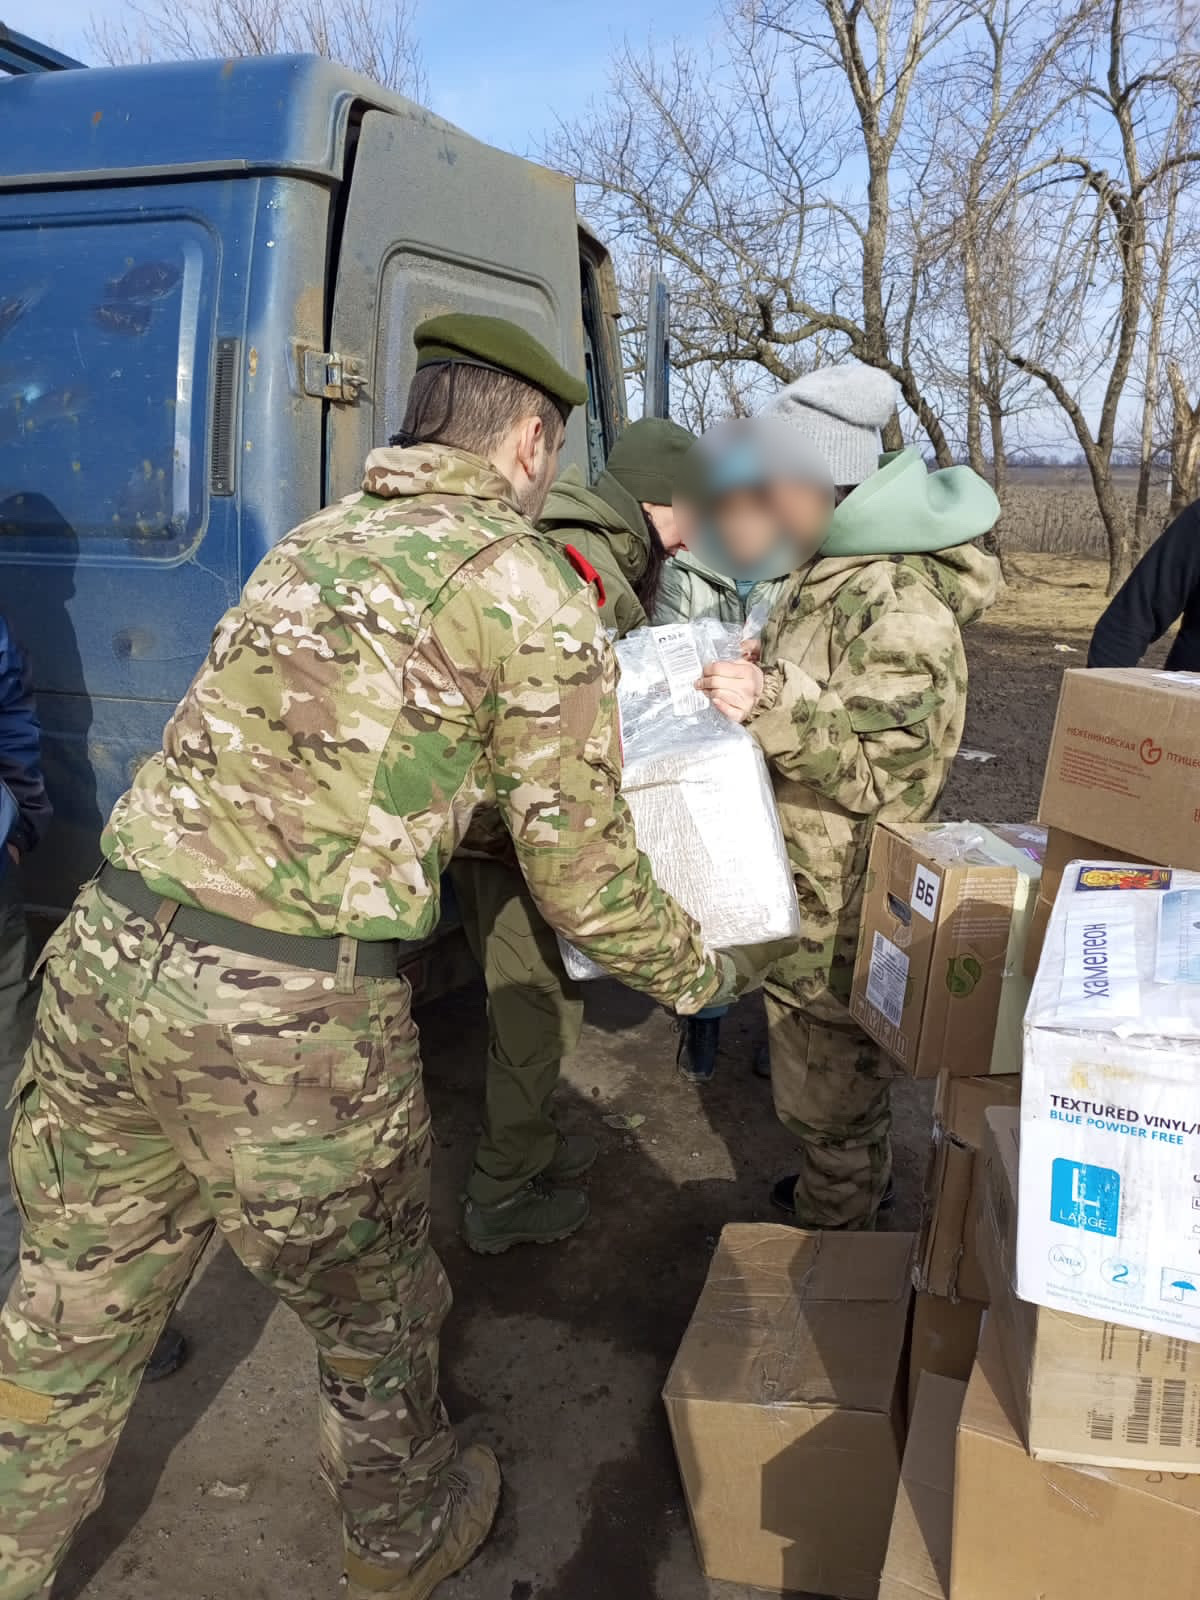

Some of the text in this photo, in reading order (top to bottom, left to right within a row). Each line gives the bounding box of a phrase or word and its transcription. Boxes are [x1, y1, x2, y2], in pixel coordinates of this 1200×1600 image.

[1050, 1094, 1140, 1123] TEXTURED
[1049, 1109, 1184, 1145] BLUE POWDER FREE
[1112, 1264, 1129, 1285] 2
